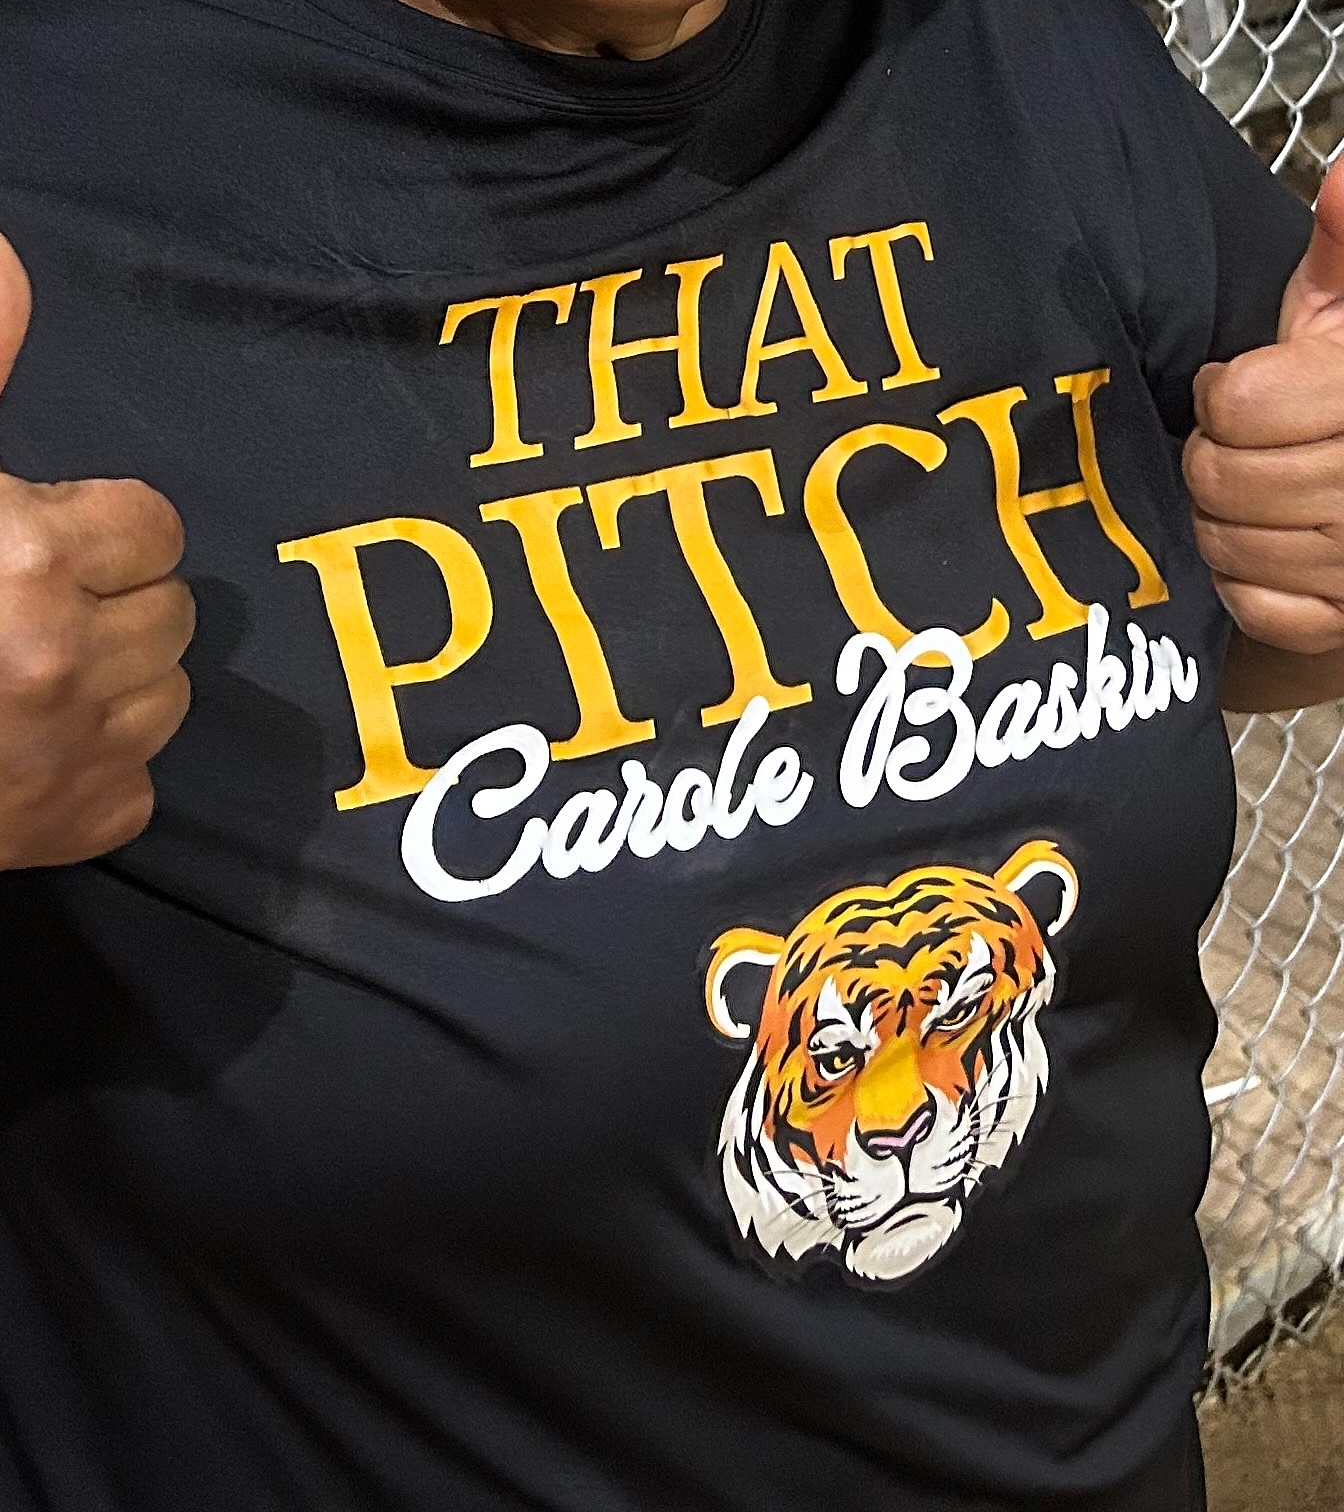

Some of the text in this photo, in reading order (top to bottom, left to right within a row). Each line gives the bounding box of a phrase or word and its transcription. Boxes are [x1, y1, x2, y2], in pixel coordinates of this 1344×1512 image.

[439, 221, 940, 468] THAT
[277, 367, 1169, 810] PITCH
[400, 603, 1199, 902] Carole Baskin
